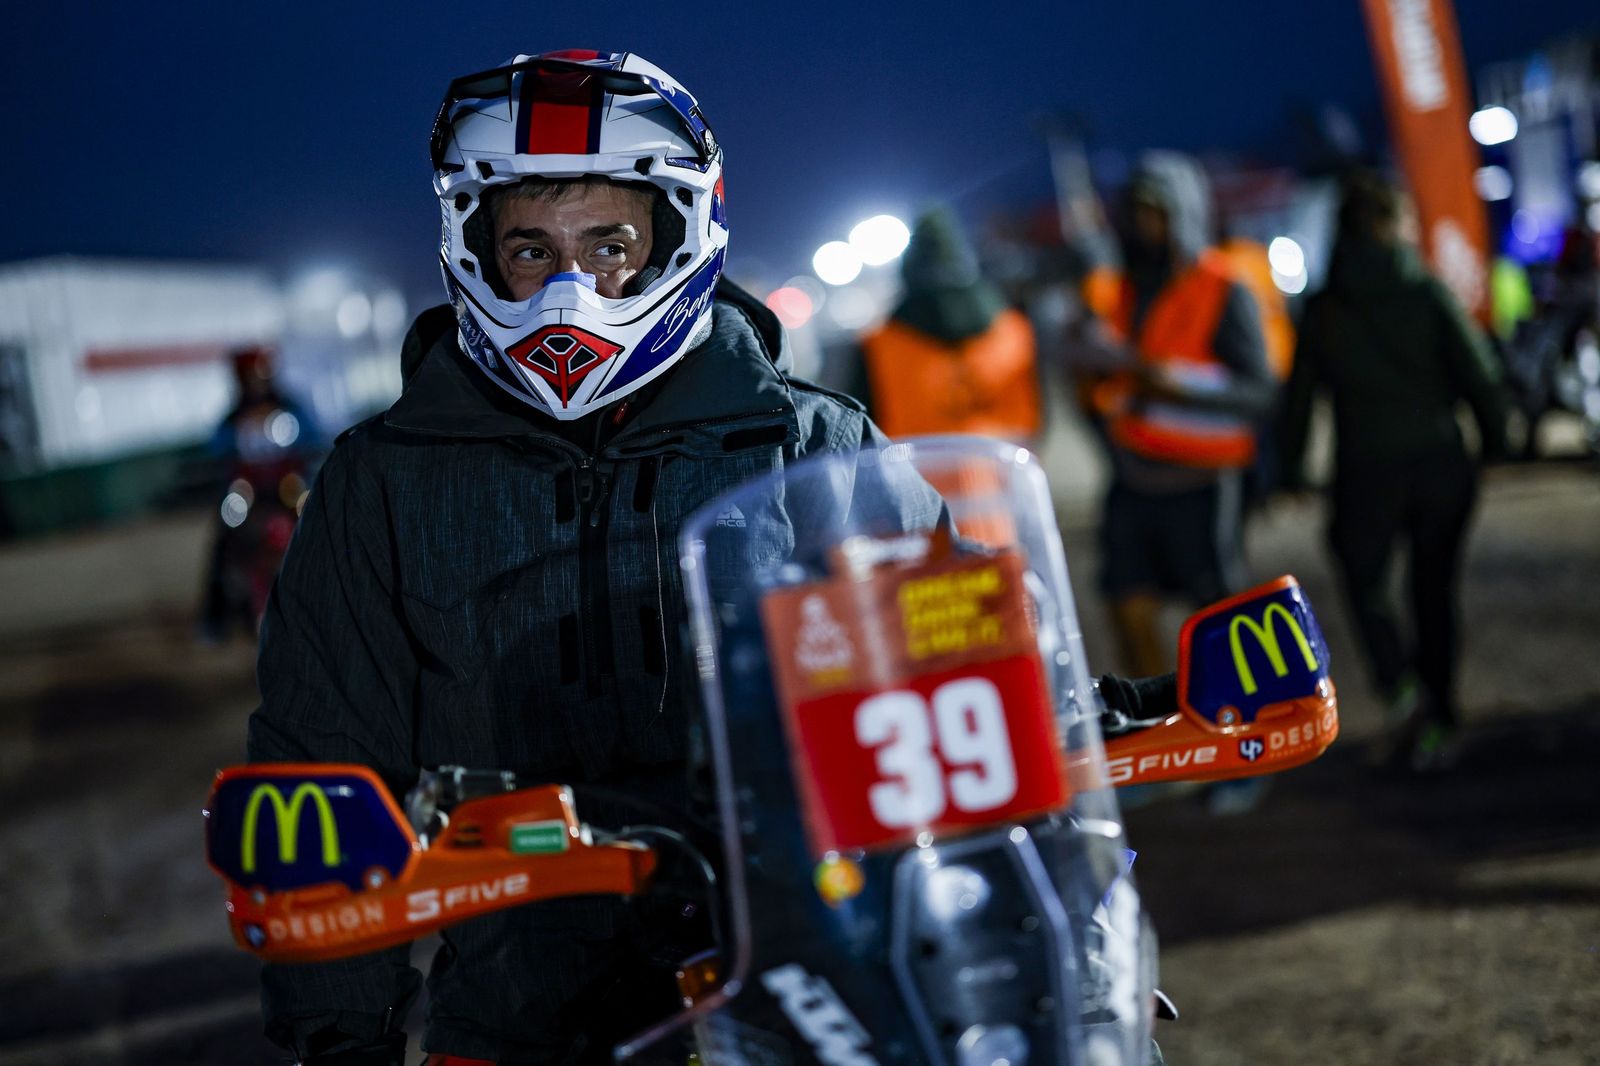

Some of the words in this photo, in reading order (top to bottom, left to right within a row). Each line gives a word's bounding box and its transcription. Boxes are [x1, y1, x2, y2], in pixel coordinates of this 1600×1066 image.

[716, 519, 747, 528] ACG
[854, 676, 1018, 829] 39
[1138, 746, 1218, 774] FIVE
[445, 873, 529, 909] FIVE
[269, 901, 384, 941] DESIGN
